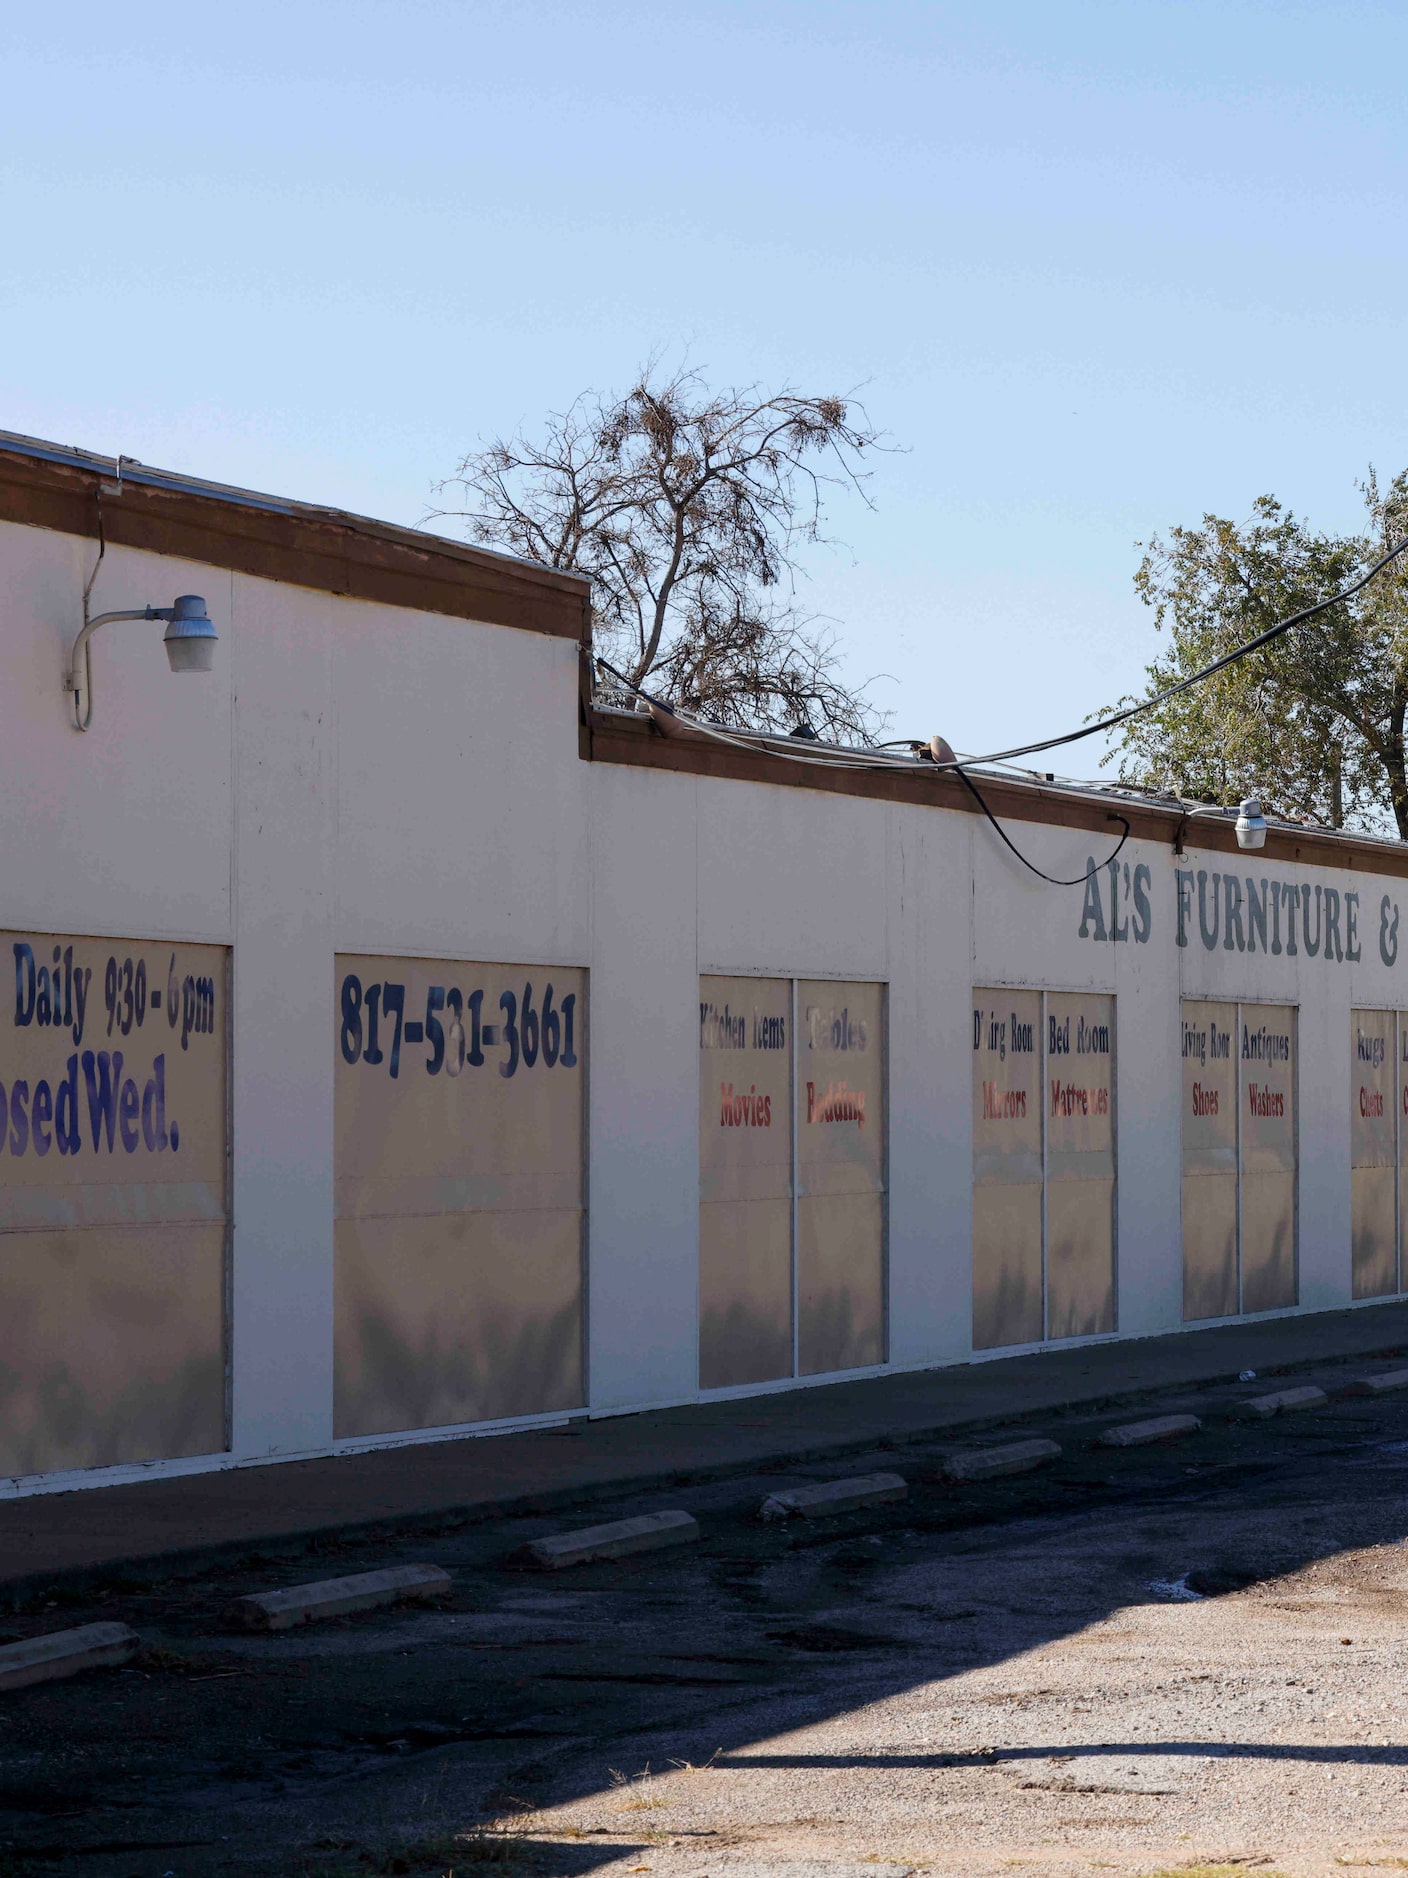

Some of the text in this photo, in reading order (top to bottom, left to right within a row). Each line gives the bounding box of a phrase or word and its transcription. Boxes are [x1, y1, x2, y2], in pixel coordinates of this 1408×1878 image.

[1078, 856, 1152, 944] AL'S
[1174, 869, 1362, 963] FURNITURE
[1379, 894, 1399, 967] &
[13, 943, 92, 1046] Daily
[341, 974, 577, 1079] 817-531-3661
[1049, 1015, 1109, 1054] Bed Room
[1181, 1021, 1206, 1067] Living
[1241, 1024, 1289, 1068] Antiques
[720, 1082, 771, 1127] Movies
[806, 1079, 866, 1130] Bedding
[1192, 1081, 1219, 1117] Shoes
[1248, 1082, 1284, 1117] Washers
